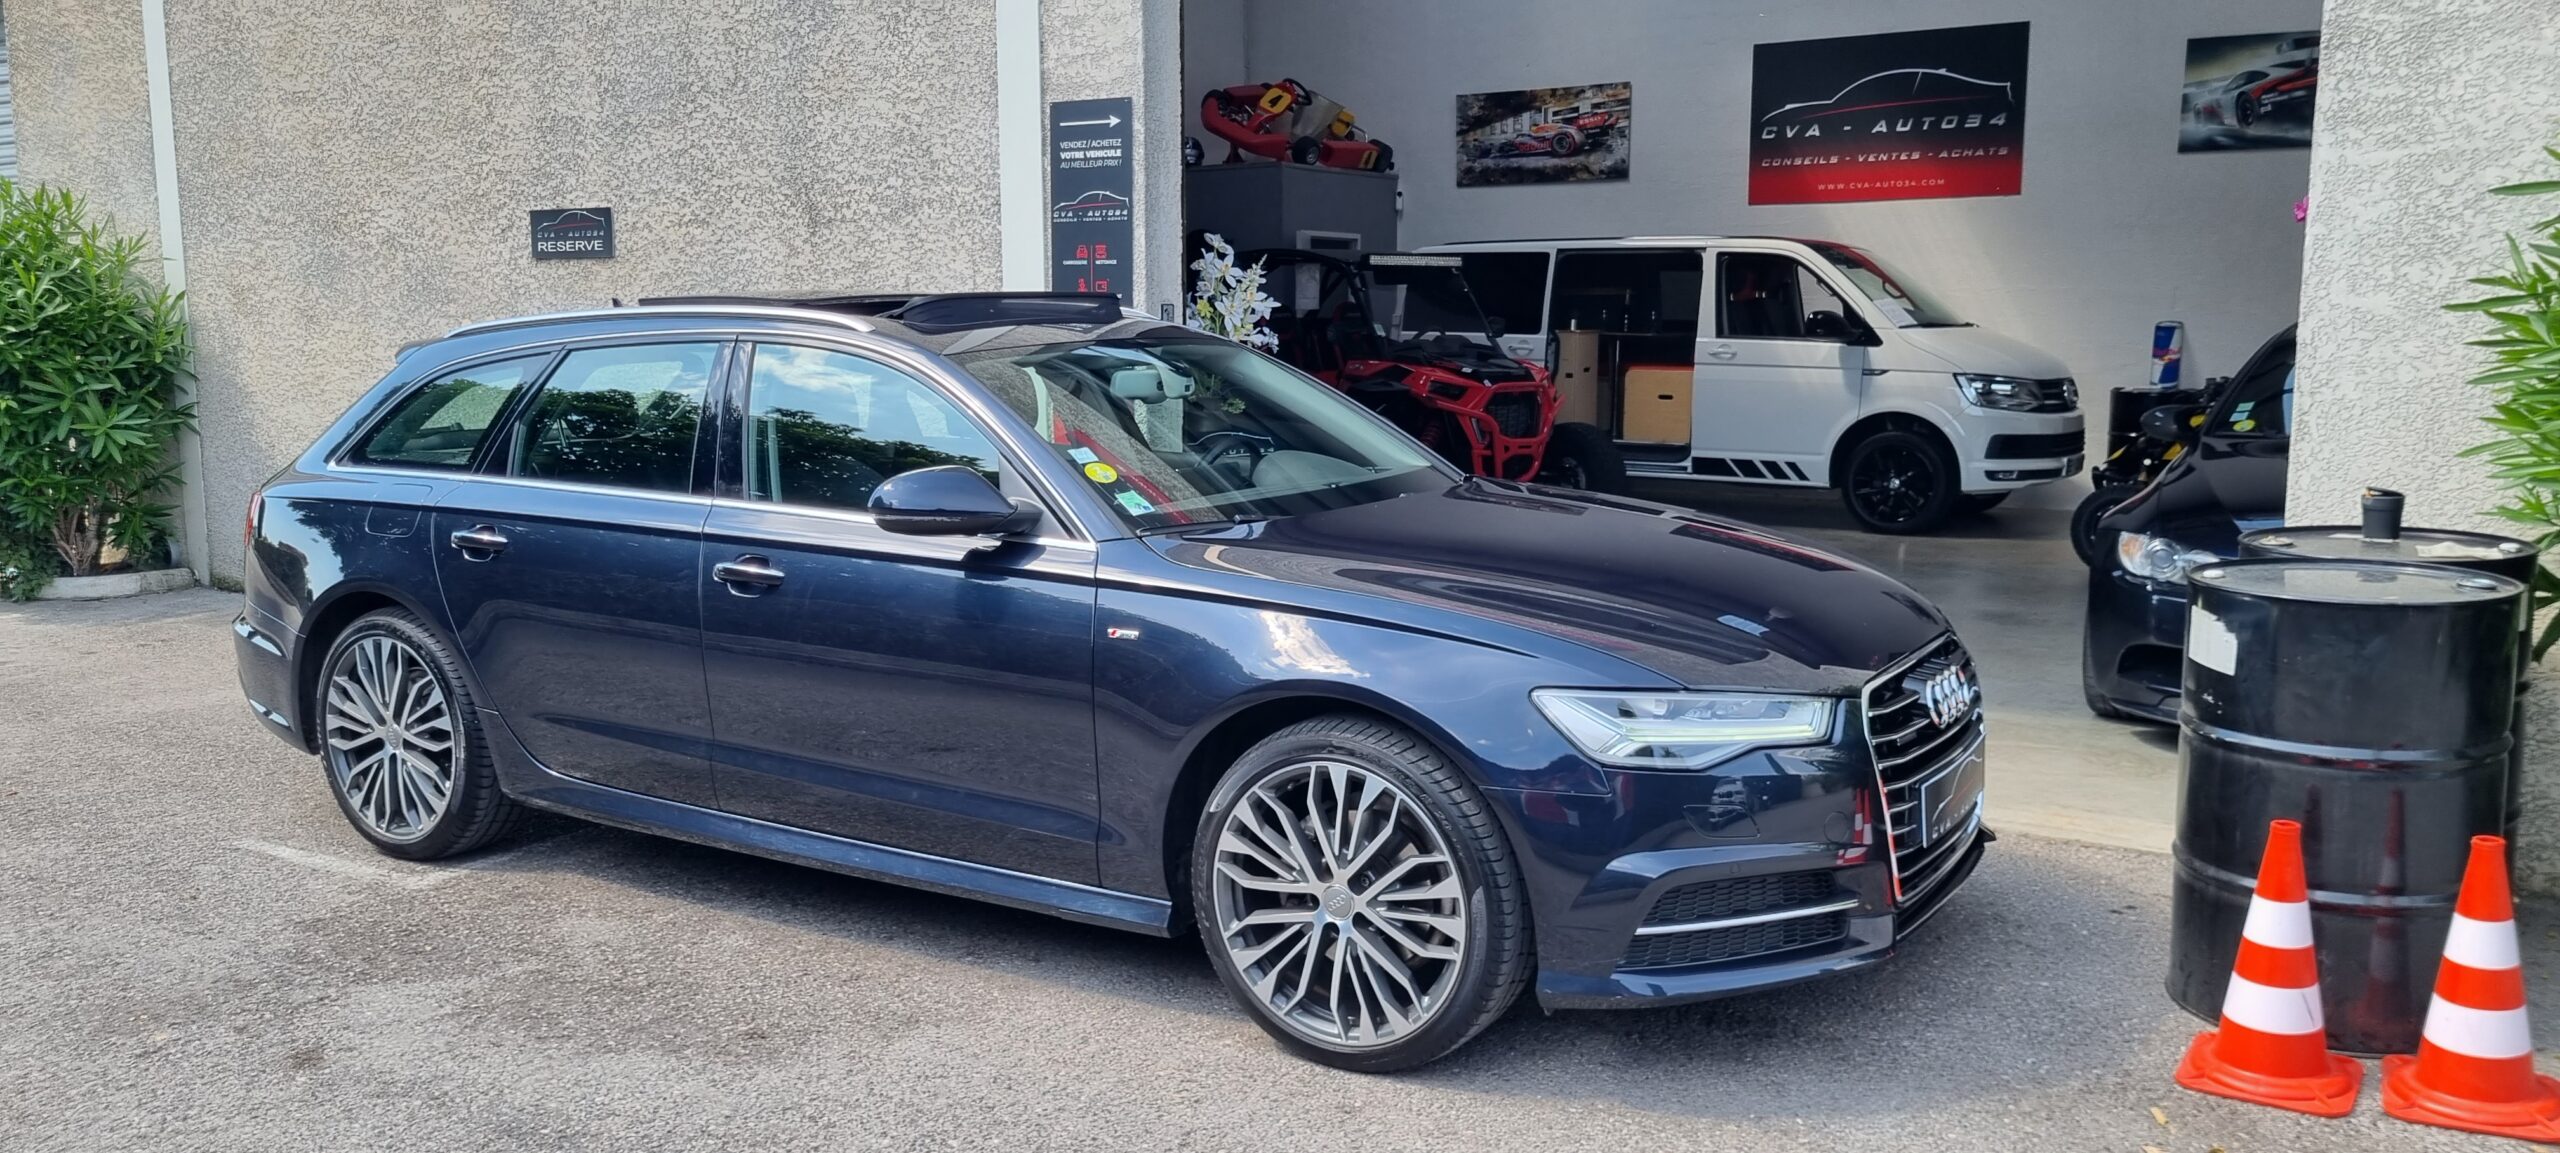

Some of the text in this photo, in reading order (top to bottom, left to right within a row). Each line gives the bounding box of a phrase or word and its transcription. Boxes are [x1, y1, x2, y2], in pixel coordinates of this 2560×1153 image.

[1268, 94, 1284, 108] 4
[1761, 123, 1821, 140] CVA
[1871, 112, 2007, 134] AUTO34
[1060, 140, 1087, 149] VENDEZ
[1091, 138, 1122, 147] ACHETEZ
[1060, 149, 1122, 159] VOTRE VEHICULE
[1761, 155, 1839, 167] CONSEILS
[1857, 151, 1921, 163] VENTES
[1938, 146, 2009, 159] ACHATS
[1060, 161, 1070, 169] AU
[1070, 160, 1103, 168] MEILLEUR
[1817, 178, 1946, 191] WWW.CVA-AUTO34.COM
[1053, 210, 1073, 218] CVA
[537, 240, 604, 252] RESERVE
